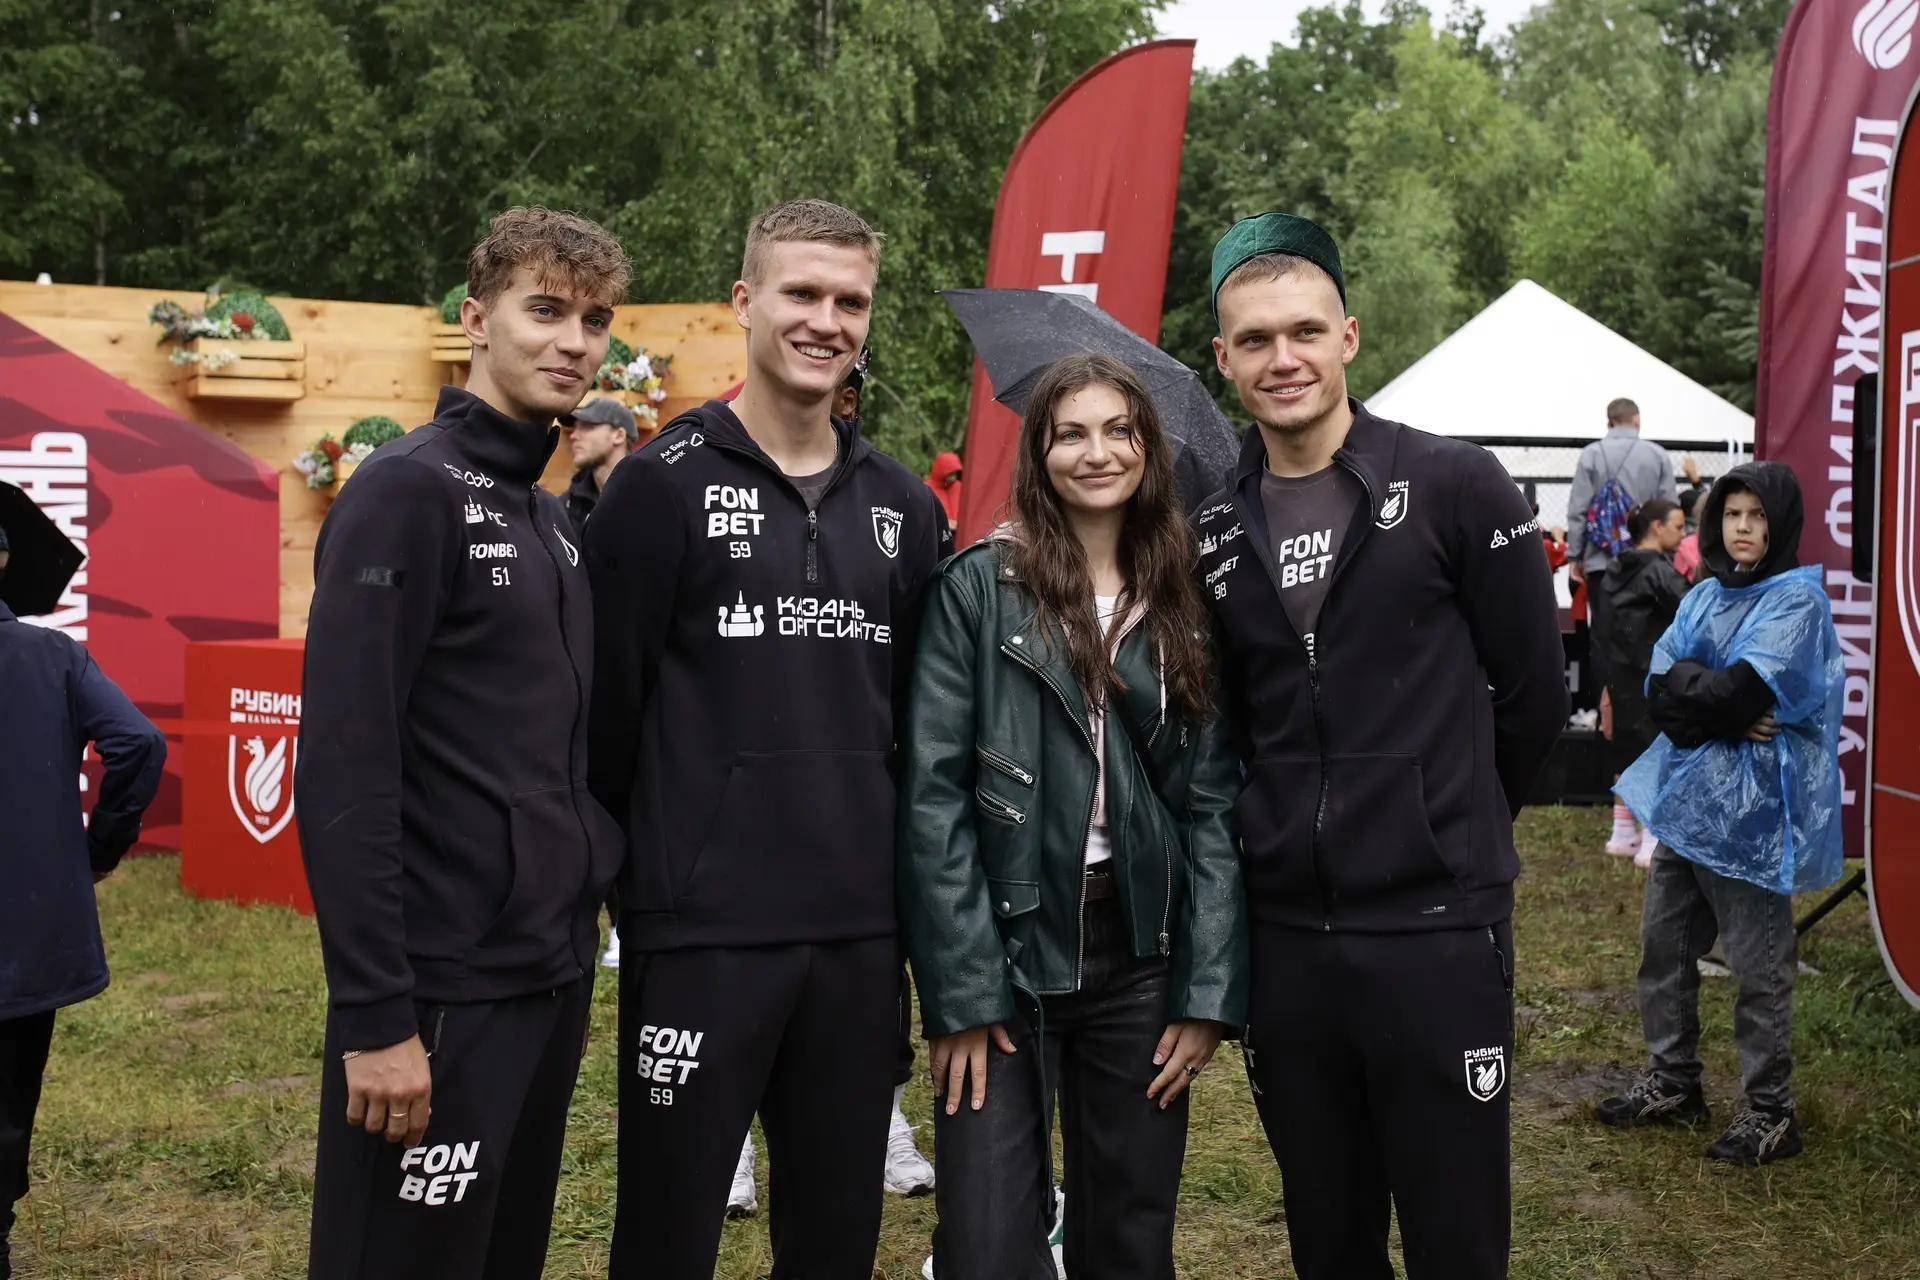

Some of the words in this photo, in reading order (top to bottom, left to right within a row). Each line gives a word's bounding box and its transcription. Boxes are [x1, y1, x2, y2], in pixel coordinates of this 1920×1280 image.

[666, 450, 686, 464] Банк
[704, 485, 758, 510] FON
[707, 512, 765, 538] BET
[730, 541, 752, 559] 59
[1279, 529, 1332, 564] FON
[492, 566, 511, 586] 51
[1281, 554, 1333, 589] BET
[1214, 581, 1227, 600] 98
[777, 596, 865, 620] КАЗАНЬ
[778, 616, 892, 645] ОРГСИНТЕ
[231, 687, 301, 717] РУБИН
[639, 1025, 704, 1057] FON
[1464, 1046, 1504, 1059] РУБИН
[638, 1052, 700, 1085] BET
[650, 1087, 673, 1106] 59
[400, 1141, 480, 1174] FON
[399, 1172, 479, 1206] BET
